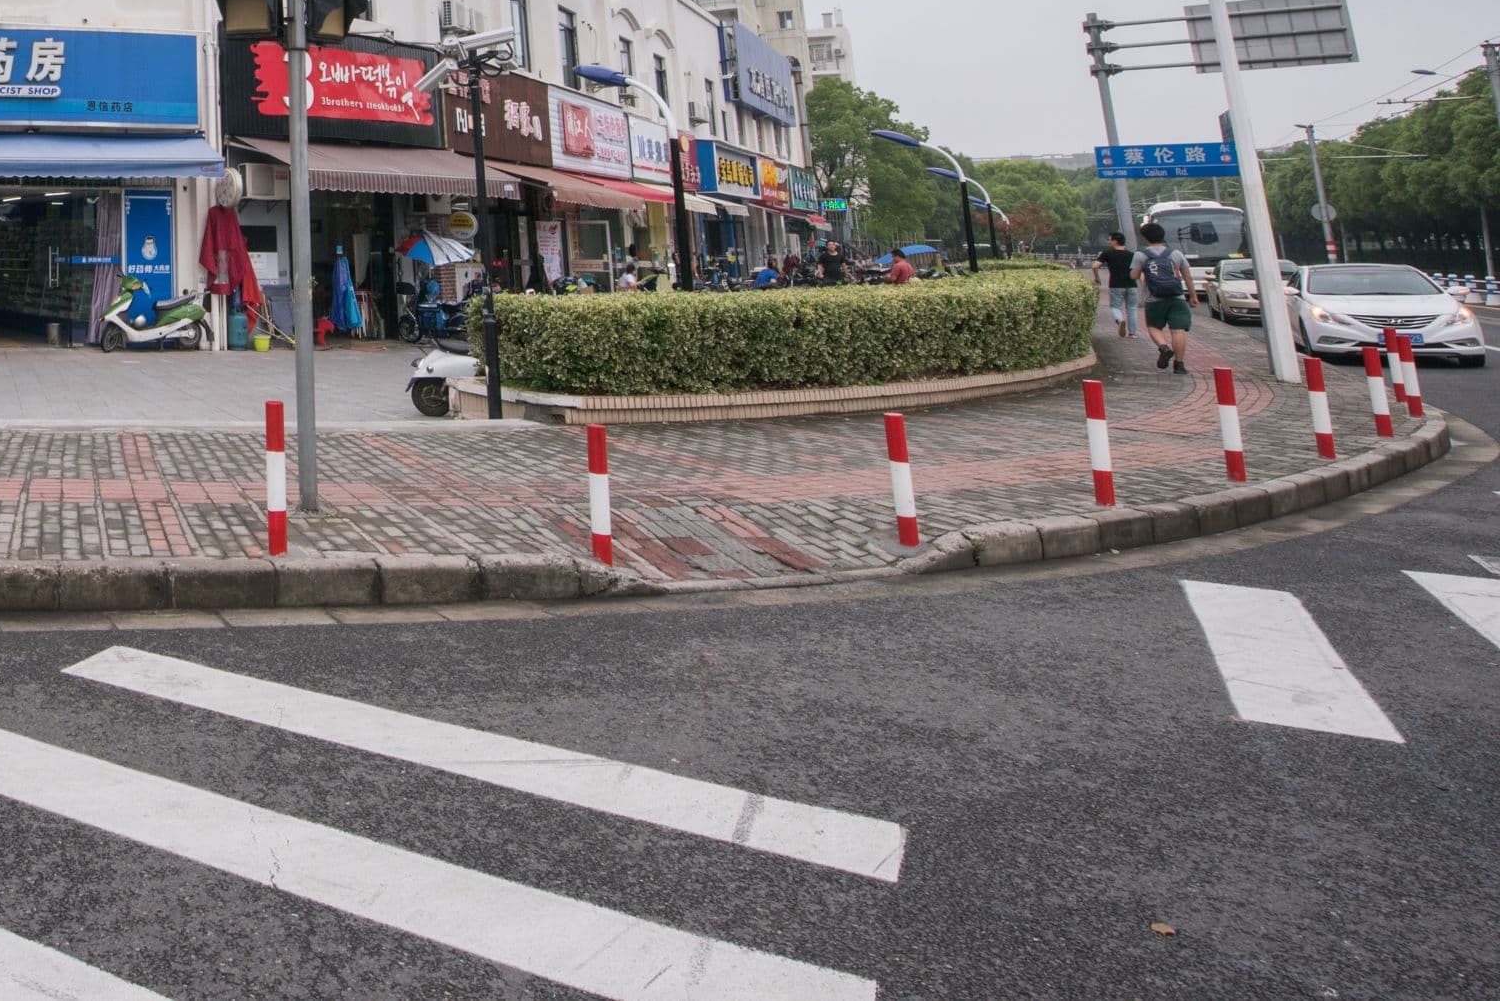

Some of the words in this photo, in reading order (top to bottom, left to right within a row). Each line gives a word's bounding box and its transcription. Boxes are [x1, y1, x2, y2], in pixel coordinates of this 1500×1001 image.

[27, 86, 59, 97] SHOP
[320, 96, 363, 110] 3brothers
[1123, 147, 1206, 165] 蔡伦路
[1143, 168, 1168, 177] Cailun
